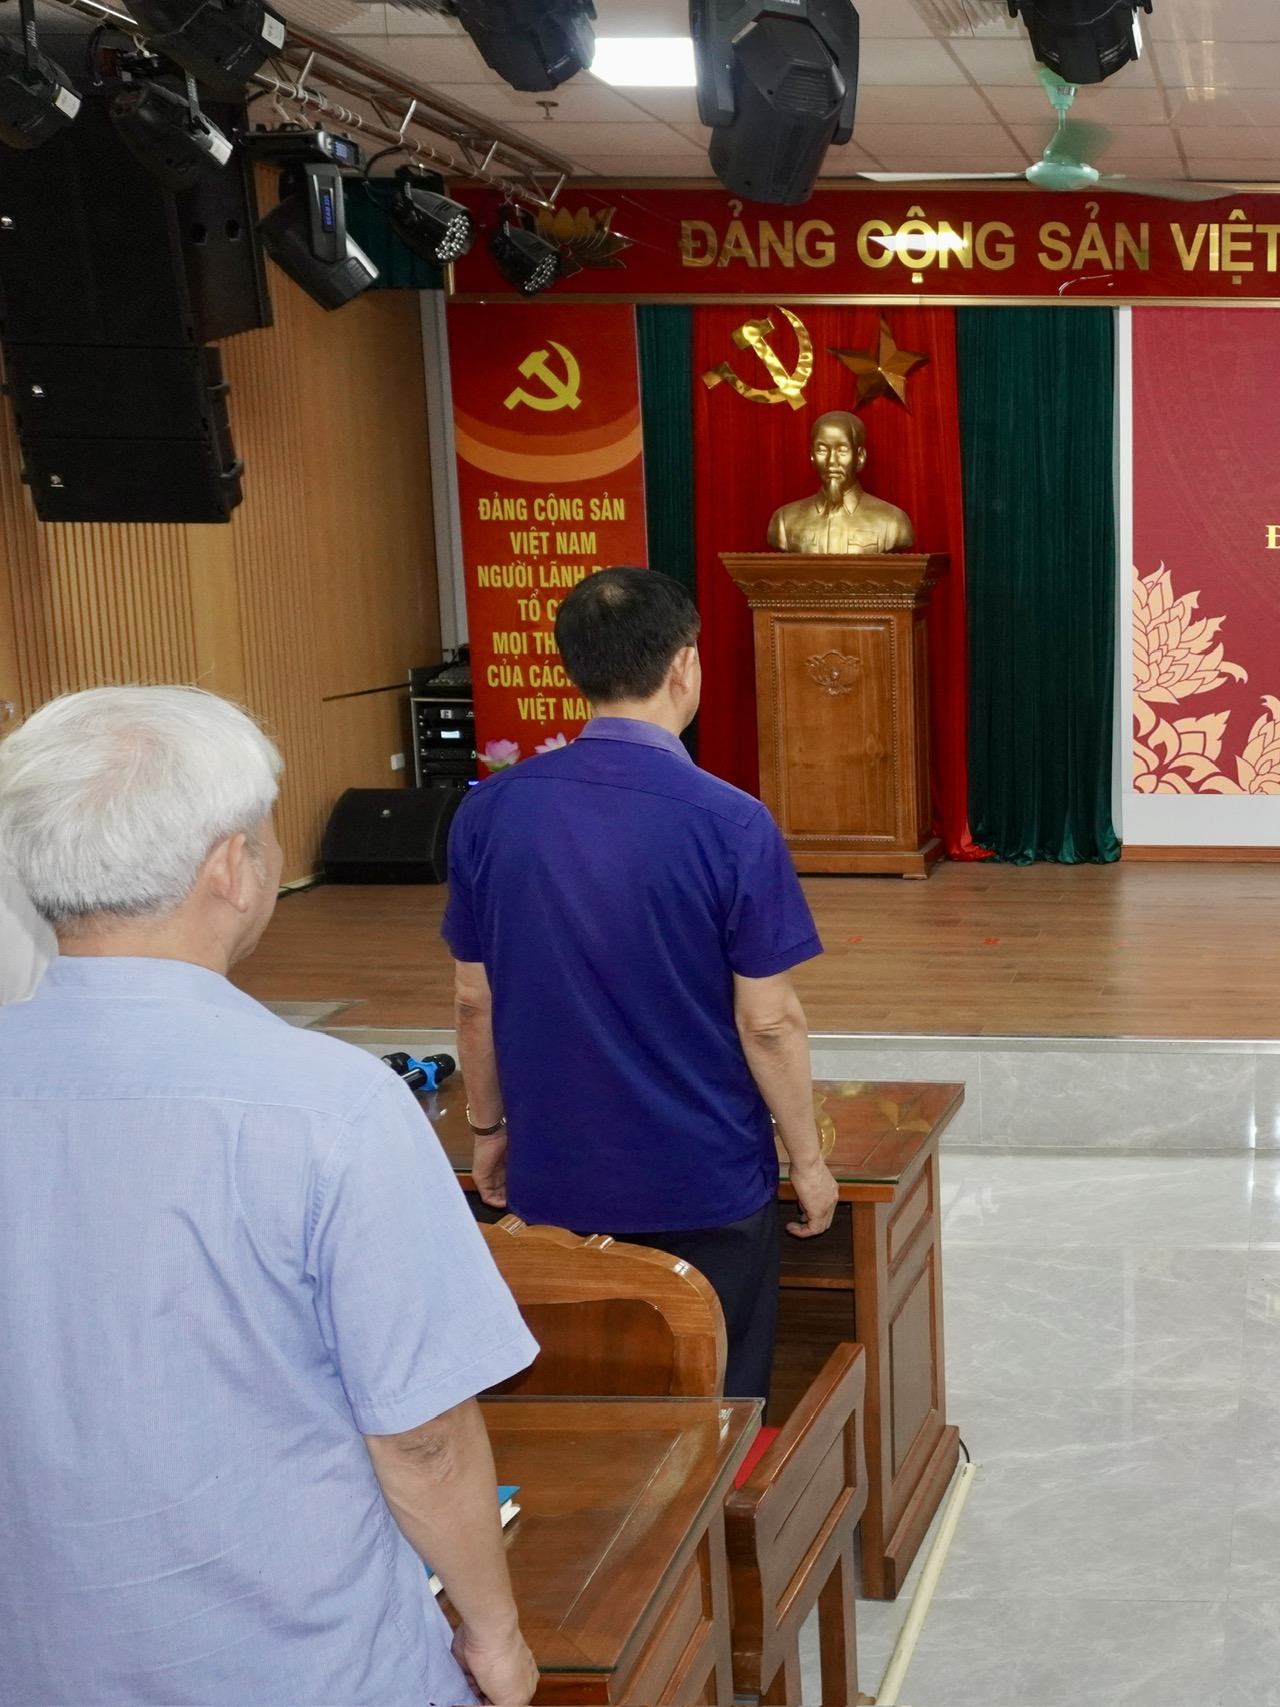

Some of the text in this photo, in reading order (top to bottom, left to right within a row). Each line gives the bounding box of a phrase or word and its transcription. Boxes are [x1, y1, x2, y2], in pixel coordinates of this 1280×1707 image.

[678, 200, 836, 268] ĐẢNG
[856, 205, 1015, 284] CỘNG
[1037, 201, 1150, 271] SẢN
[478, 492, 625, 526] ĐẢNG CỘNG SẢN
[510, 526, 597, 560] VIỆT NAM
[477, 560, 585, 588] NGƯỜI LÃNH
[518, 589, 541, 622] TỔ
[493, 631, 527, 659] MỌI
[487, 658, 524, 687] CỦA
[517, 693, 556, 725] VIỆT
